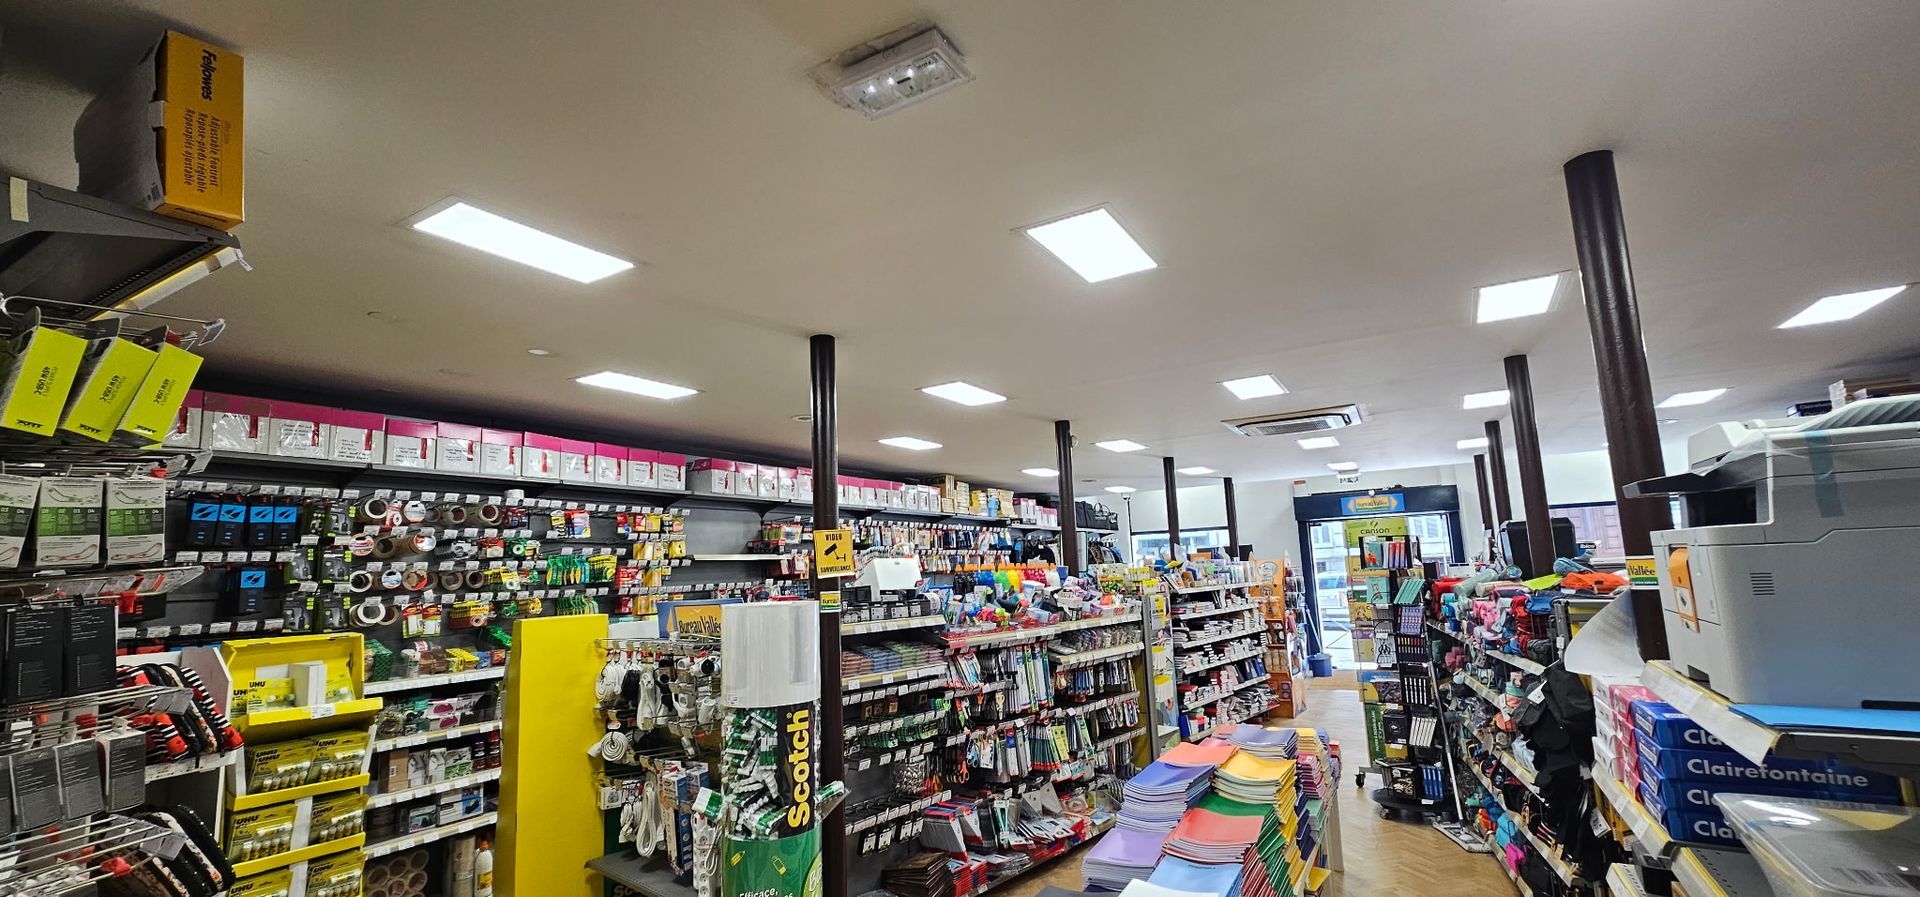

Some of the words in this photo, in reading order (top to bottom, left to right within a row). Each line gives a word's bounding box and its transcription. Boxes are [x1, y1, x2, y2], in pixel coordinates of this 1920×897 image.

[200, 49, 217, 101] Fellowes
[196, 112, 208, 161] Repose-pieds
[210, 115, 220, 155] Adjustable
[182, 150, 195, 186] ajustable
[209, 157, 219, 187] Footrest
[195, 162, 207, 193] réglable
[825, 533, 842, 541] VIDEO
[1629, 565, 1656, 576] Vallée
[678, 619, 701, 634] Bureau
[319, 739, 338, 747] UHU
[258, 754, 280, 762] UHU
[787, 709, 810, 828] Scotch
[1687, 757, 1869, 788] Clairefontaine
[313, 806, 333, 816] UHU
[237, 815, 258, 824] UHU
[314, 864, 333, 873] UHU
[230, 882, 254, 894] UHU
